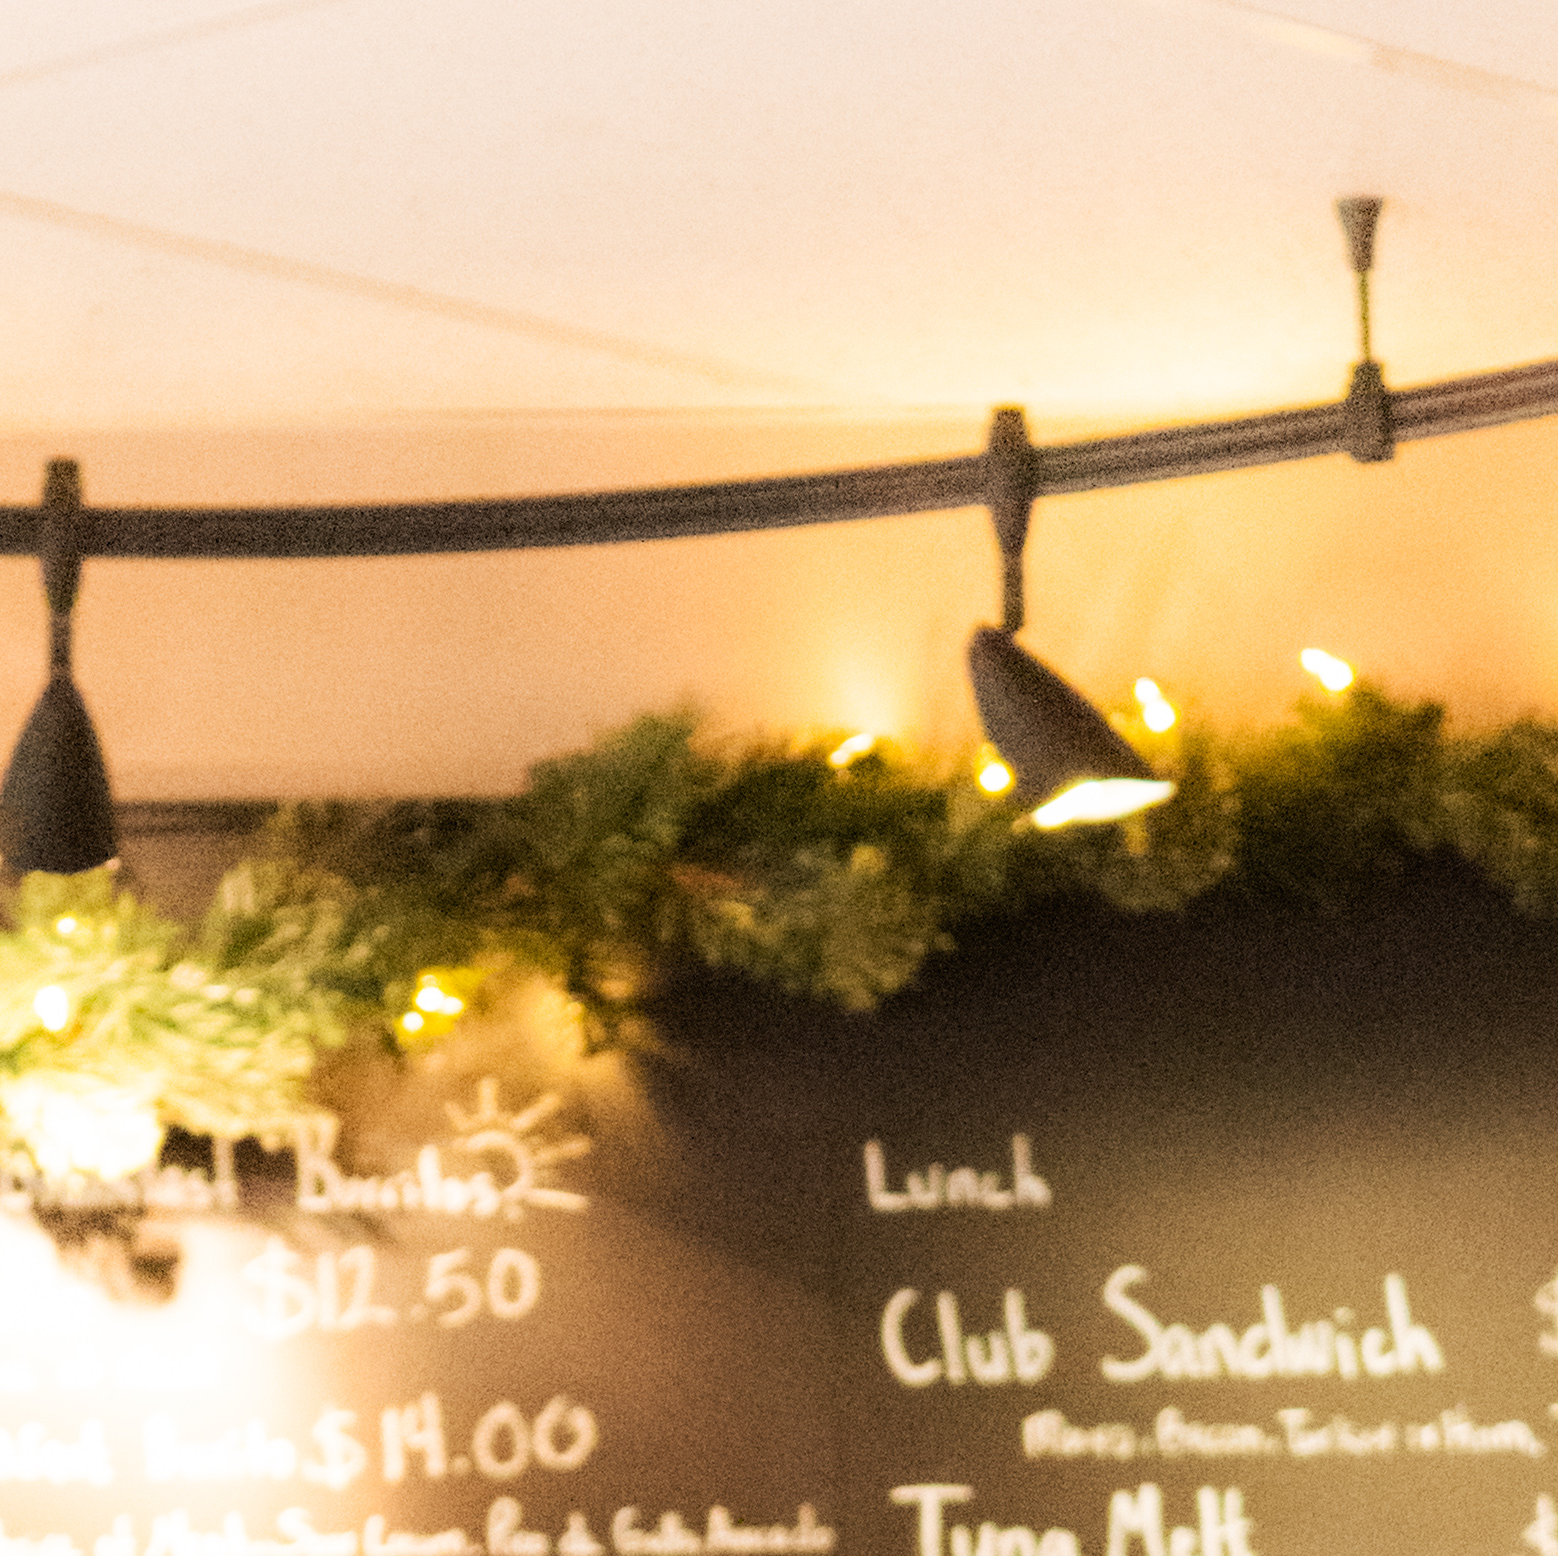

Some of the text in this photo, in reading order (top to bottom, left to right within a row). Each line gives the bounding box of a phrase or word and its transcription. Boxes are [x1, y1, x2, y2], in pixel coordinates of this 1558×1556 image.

[864, 1132, 1053, 1212] Lunch
[241, 1237, 543, 1342] $12.50
[880, 1286, 1056, 1388] Club
[1100, 1264, 1445, 1381] Sandwich
[301, 1390, 599, 1490] $14.00
